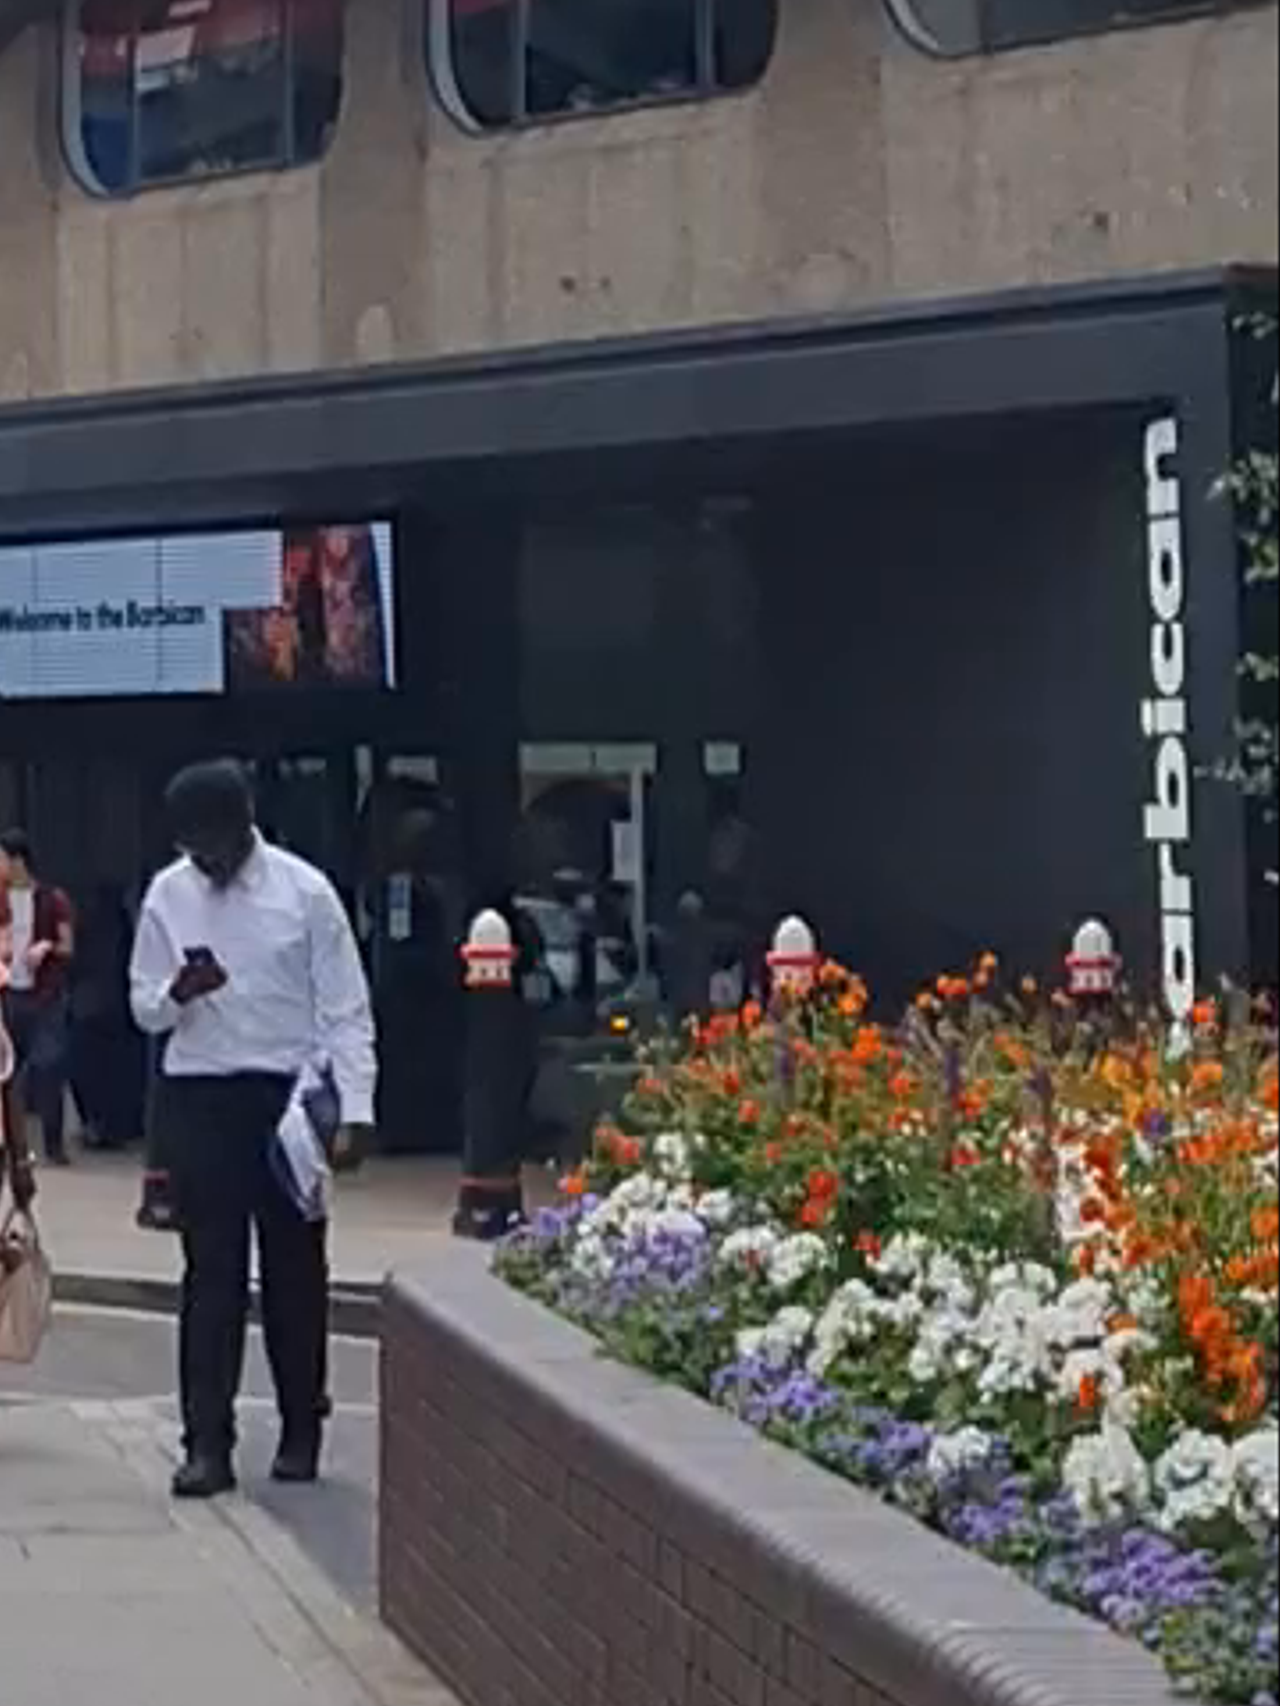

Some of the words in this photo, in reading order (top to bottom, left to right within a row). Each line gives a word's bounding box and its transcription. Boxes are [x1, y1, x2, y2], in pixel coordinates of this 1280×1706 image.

[76, 605, 92, 632] to
[97, 600, 124, 630] the
[126, 599, 206, 628] Barbican
